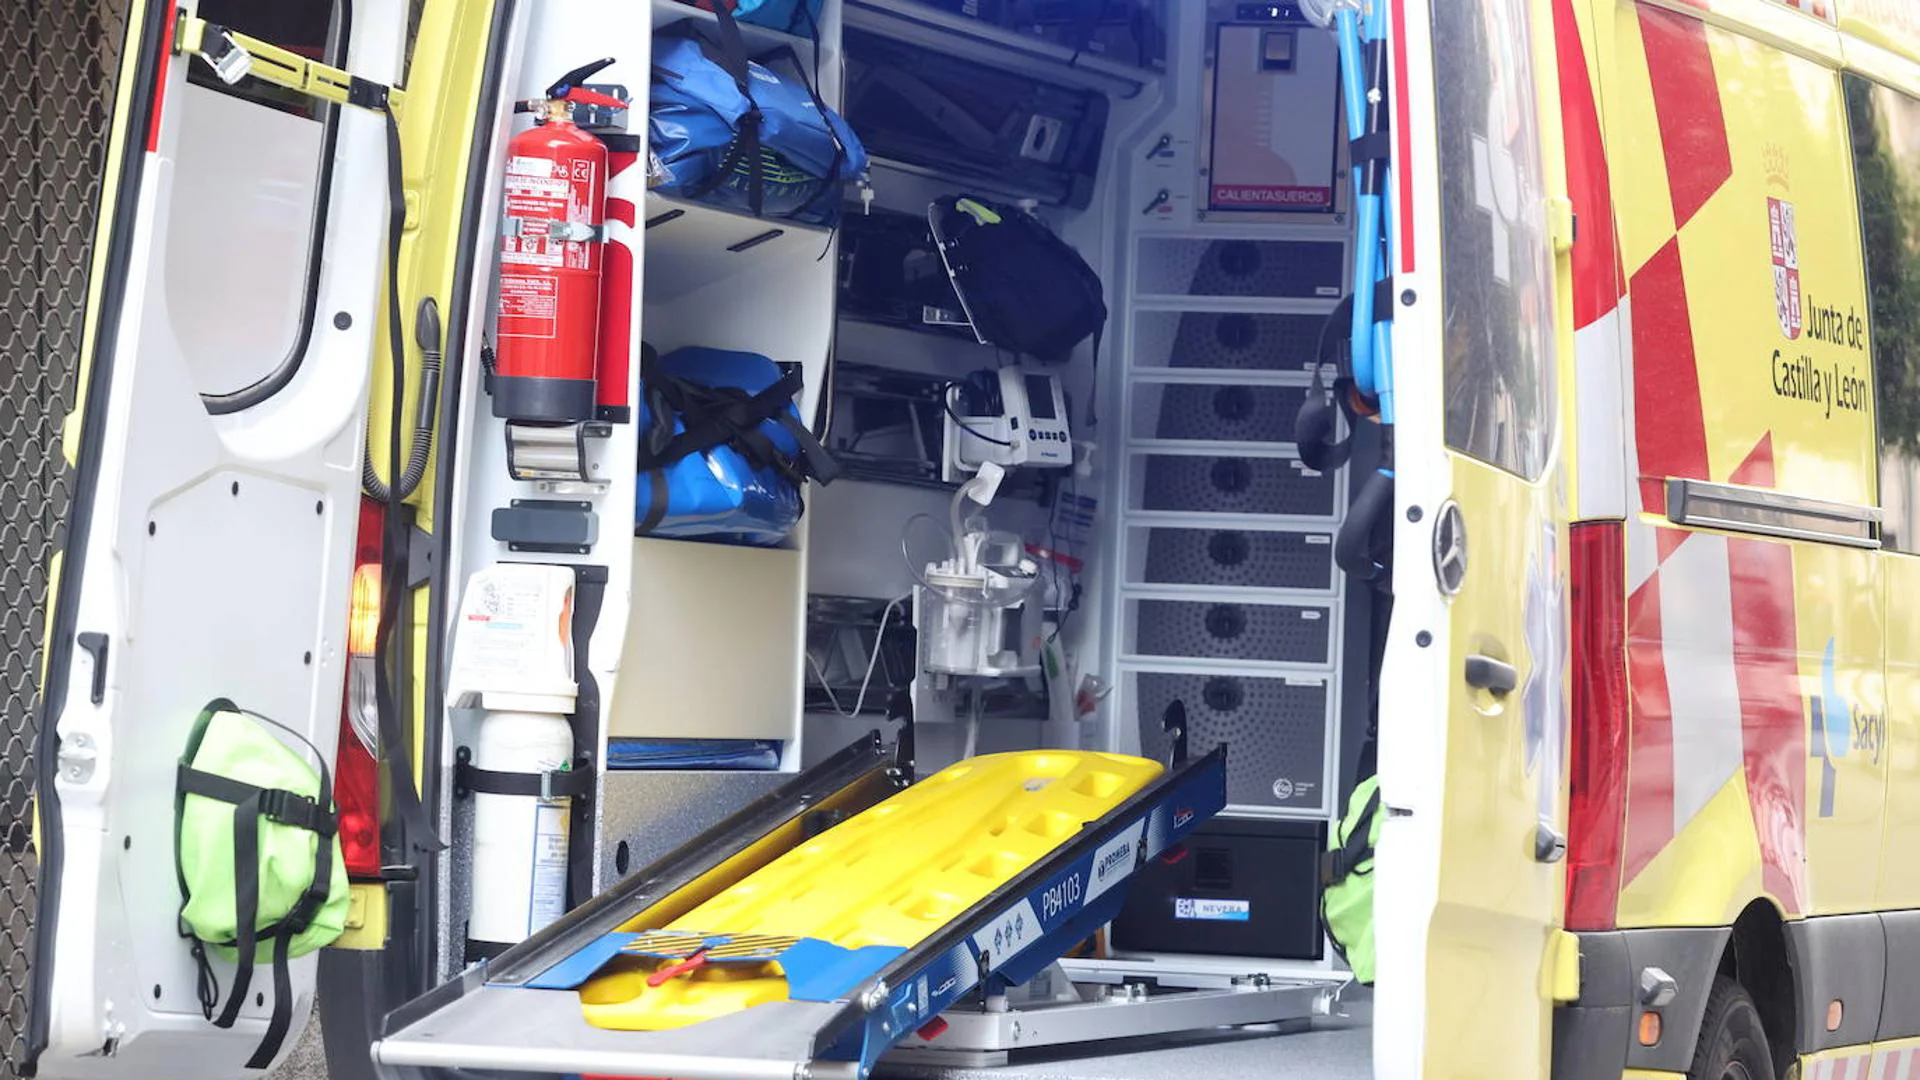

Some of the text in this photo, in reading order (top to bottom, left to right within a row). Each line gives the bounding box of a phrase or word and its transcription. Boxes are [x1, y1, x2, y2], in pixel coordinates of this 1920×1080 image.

[1217, 188, 1324, 203] CALIENTASUEROS
[1807, 294, 1863, 350] Junta de
[1772, 349, 1867, 419] Castilla y León
[1853, 703, 1885, 765] Sacyl
[1042, 872, 1081, 921] PB4103
[1202, 904, 1242, 914] NEVERA
